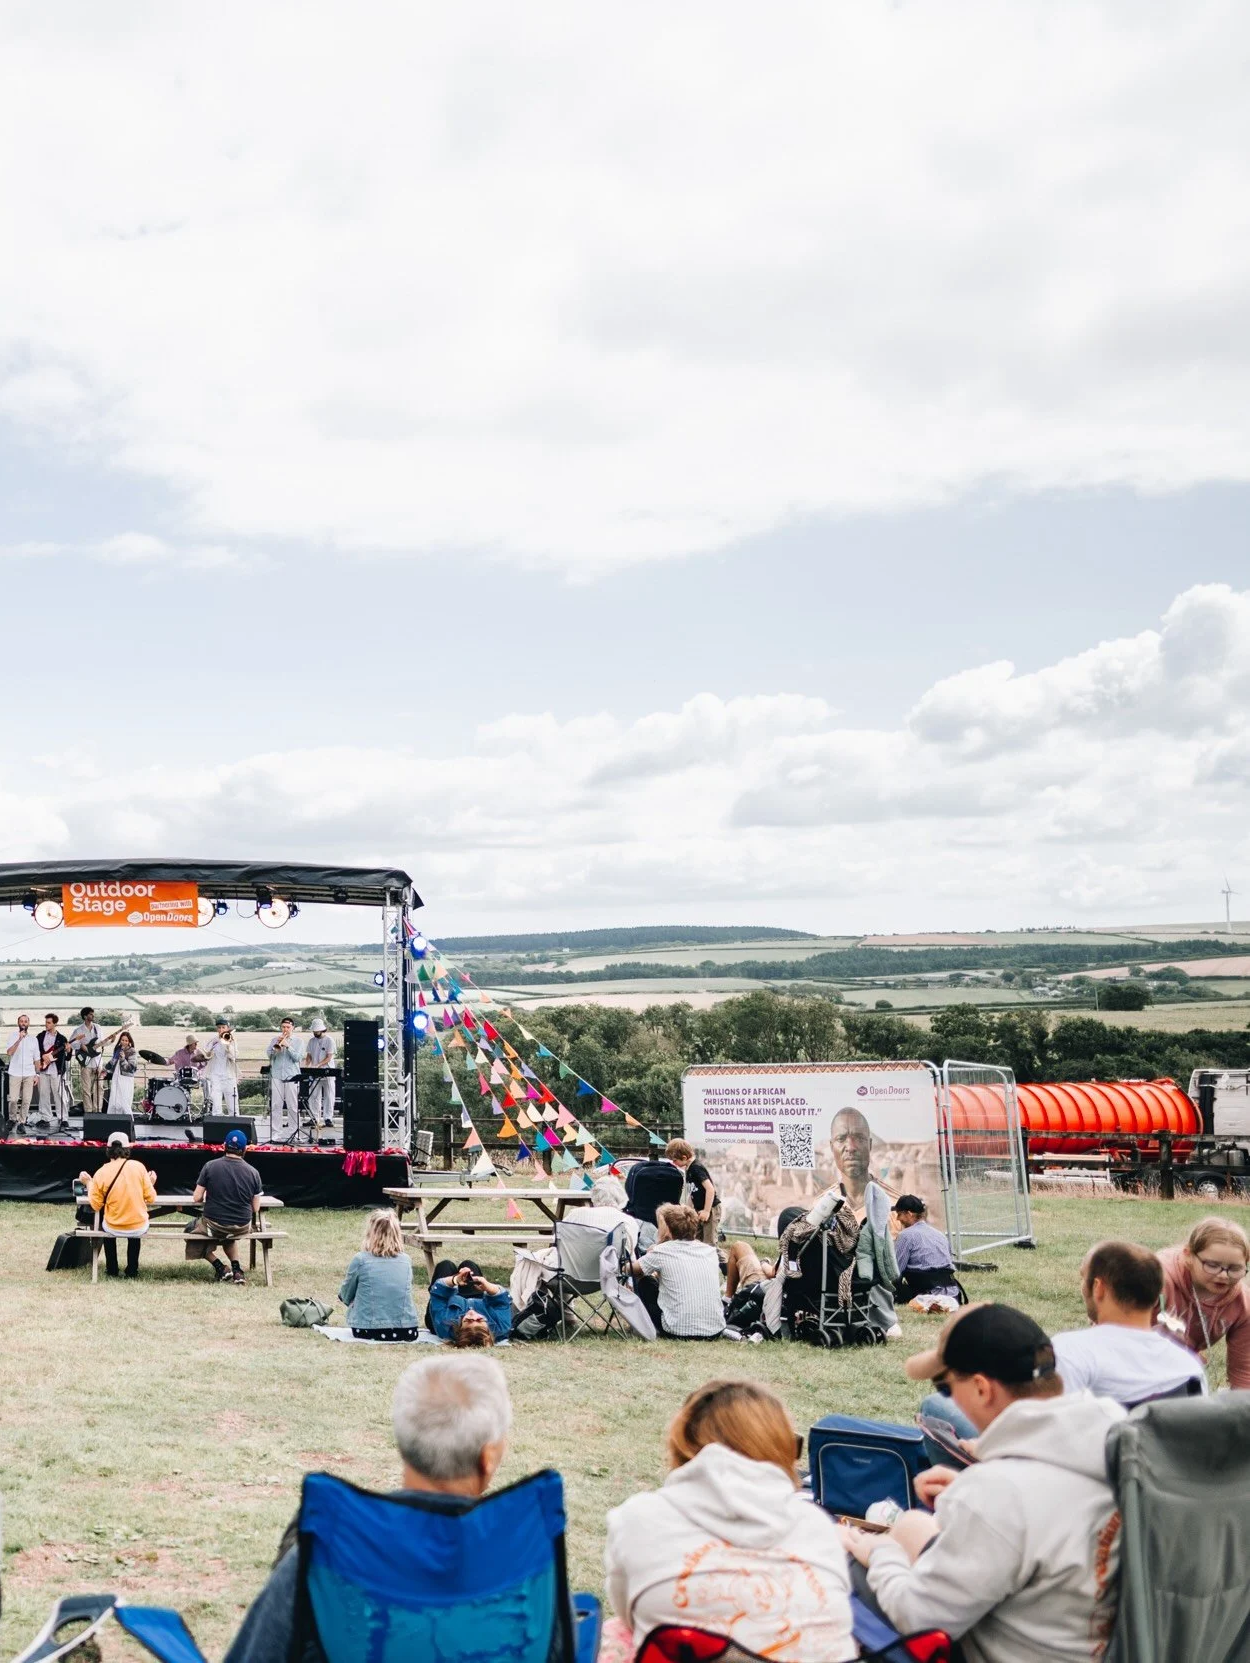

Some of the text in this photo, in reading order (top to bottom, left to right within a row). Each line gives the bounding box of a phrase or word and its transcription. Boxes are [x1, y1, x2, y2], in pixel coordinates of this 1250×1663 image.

[70, 881, 156, 898] Outdoor
[72, 897, 126, 916] Stage
[150, 900, 192, 910] partnering with
[742, 1088, 752, 1096] OF
[703, 1098, 808, 1106] CHRISTIANS ARE DISPLACED.
[703, 1108, 734, 1116] NOBODY
[736, 1108, 744, 1116] IS
[744, 1108, 778, 1116] TALKING
[778, 1108, 806, 1116] ABOUT
[706, 1123, 717, 1131] Sign
[753, 1124, 772, 1132] petition
